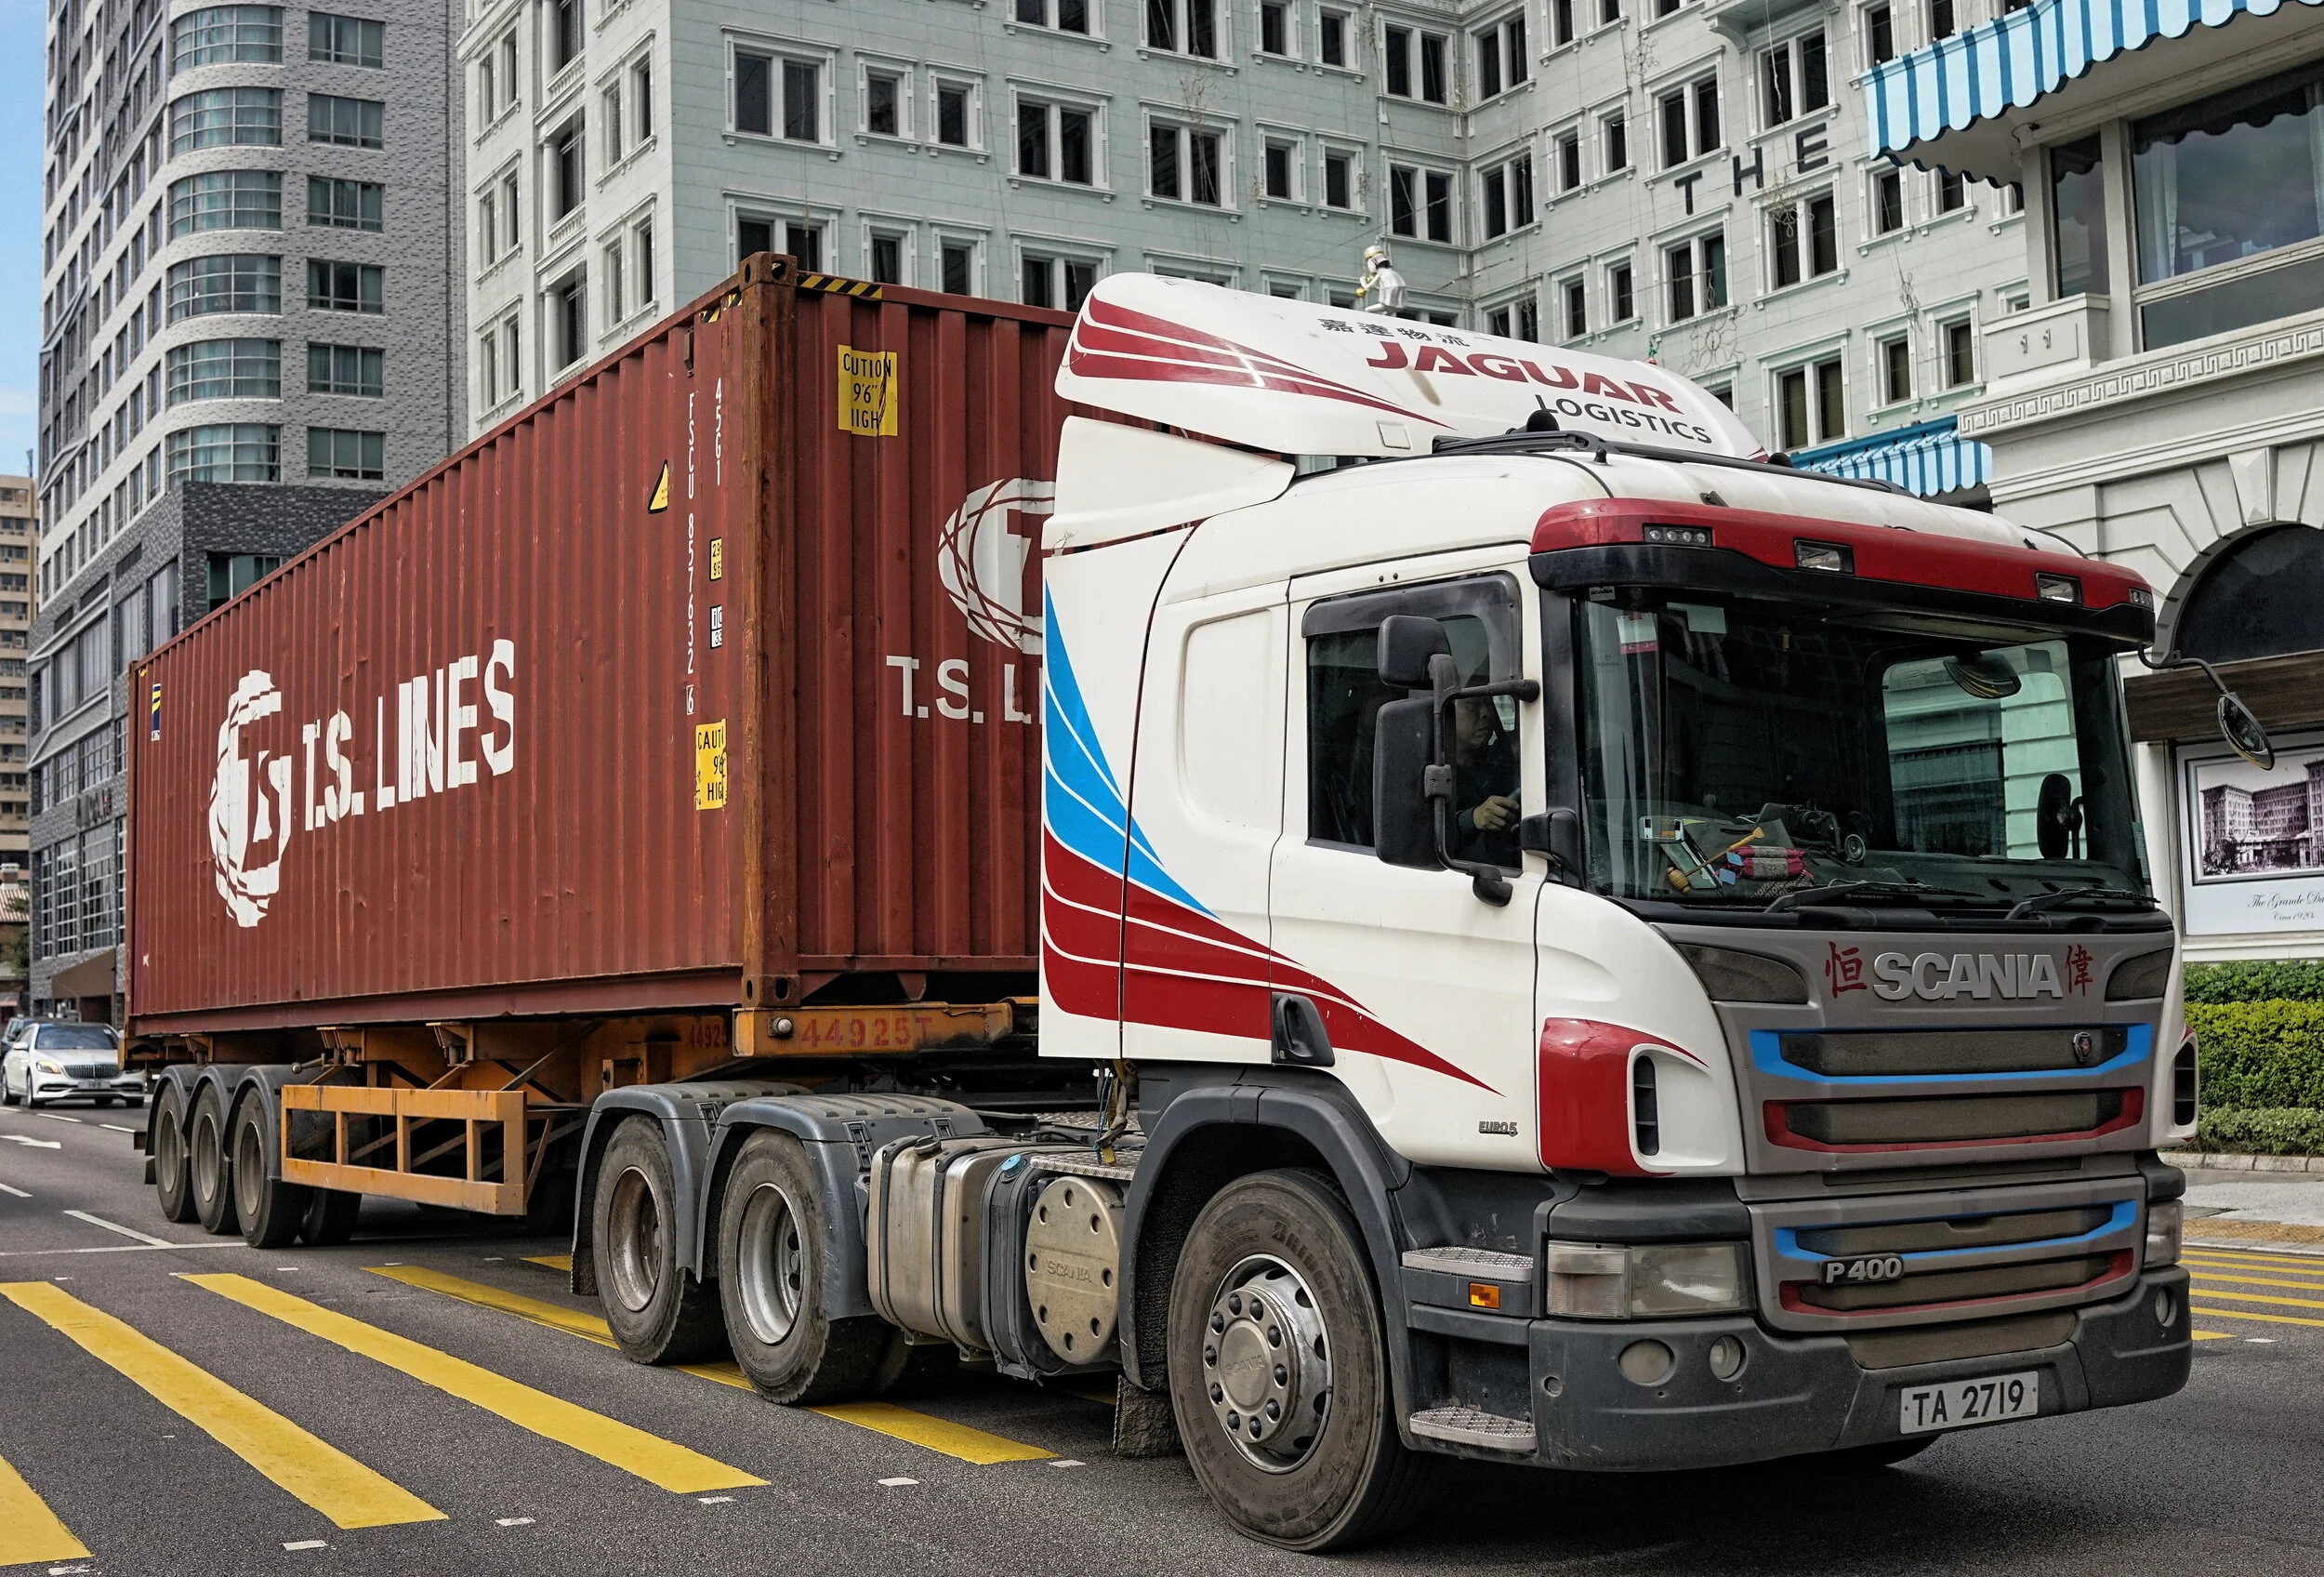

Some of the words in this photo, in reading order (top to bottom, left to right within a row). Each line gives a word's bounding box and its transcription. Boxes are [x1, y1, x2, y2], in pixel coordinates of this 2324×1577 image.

[1674, 122, 1829, 216] THE
[1366, 340, 1684, 415] JAGUAR
[714, 377, 722, 486] 45G1
[1535, 393, 1713, 444] LOGISTICS
[686, 512, 695, 675] 857632
[886, 655, 984, 724] T.S.
[303, 709, 364, 831] T.S.
[377, 638, 515, 813] LINES
[2248, 894, 2265, 908] The
[2268, 892, 2304, 909] Grande
[1872, 951, 2064, 1001] SCANIA
[2065, 944, 2093, 998] 偉
[800, 1016, 933, 1049] 44925T
[1048, 1261, 1092, 1283] SCANIA
[1224, 1354, 1266, 1376] SCANIA
[1912, 1389, 1948, 1426] TA
[1961, 1378, 2025, 1419] 2719
